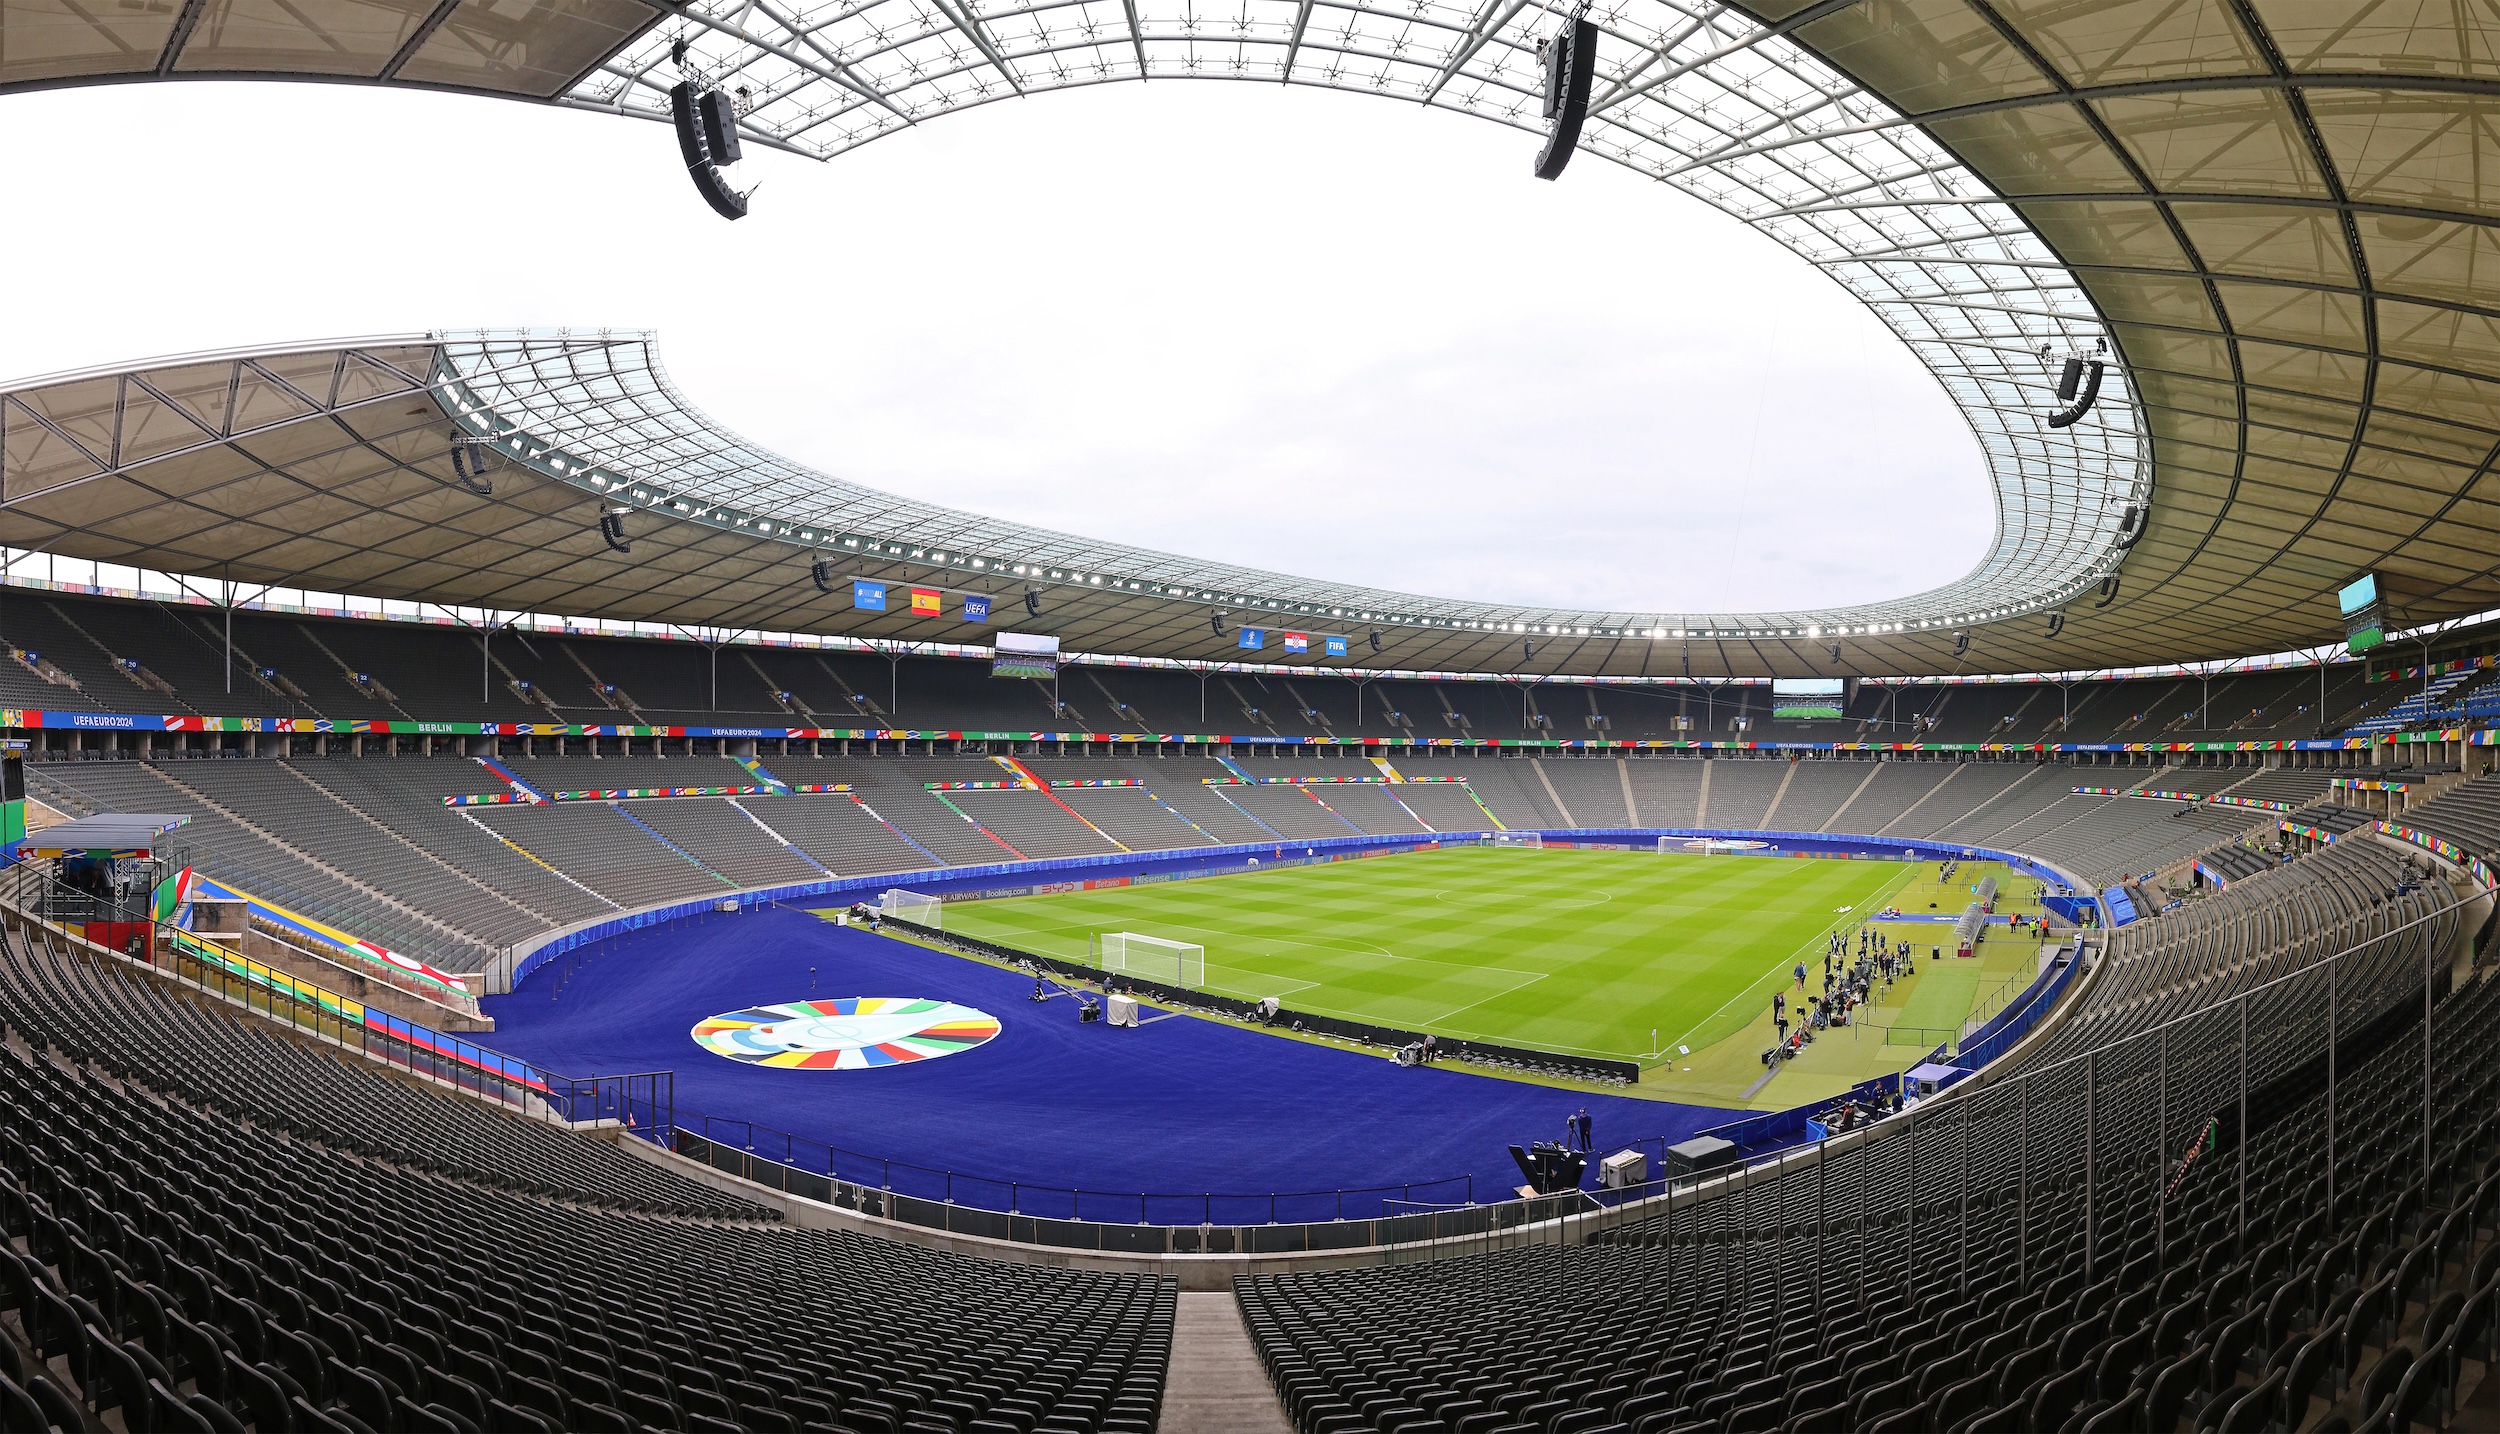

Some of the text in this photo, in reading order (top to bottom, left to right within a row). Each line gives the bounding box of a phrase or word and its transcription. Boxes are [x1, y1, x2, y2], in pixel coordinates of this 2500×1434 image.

[965, 604, 986, 615] UEFA
[1328, 641, 1345, 651] FIFA
[73, 715, 134, 727] UEFAEURO2024
[418, 723, 453, 732] BERLIN
[1094, 879, 1120, 889] Betano
[1134, 873, 1171, 885] Hisense
[986, 887, 1027, 898] Booking.com
[1041, 882, 1075, 894] BYD
[949, 891, 980, 901] AIRWAYS
